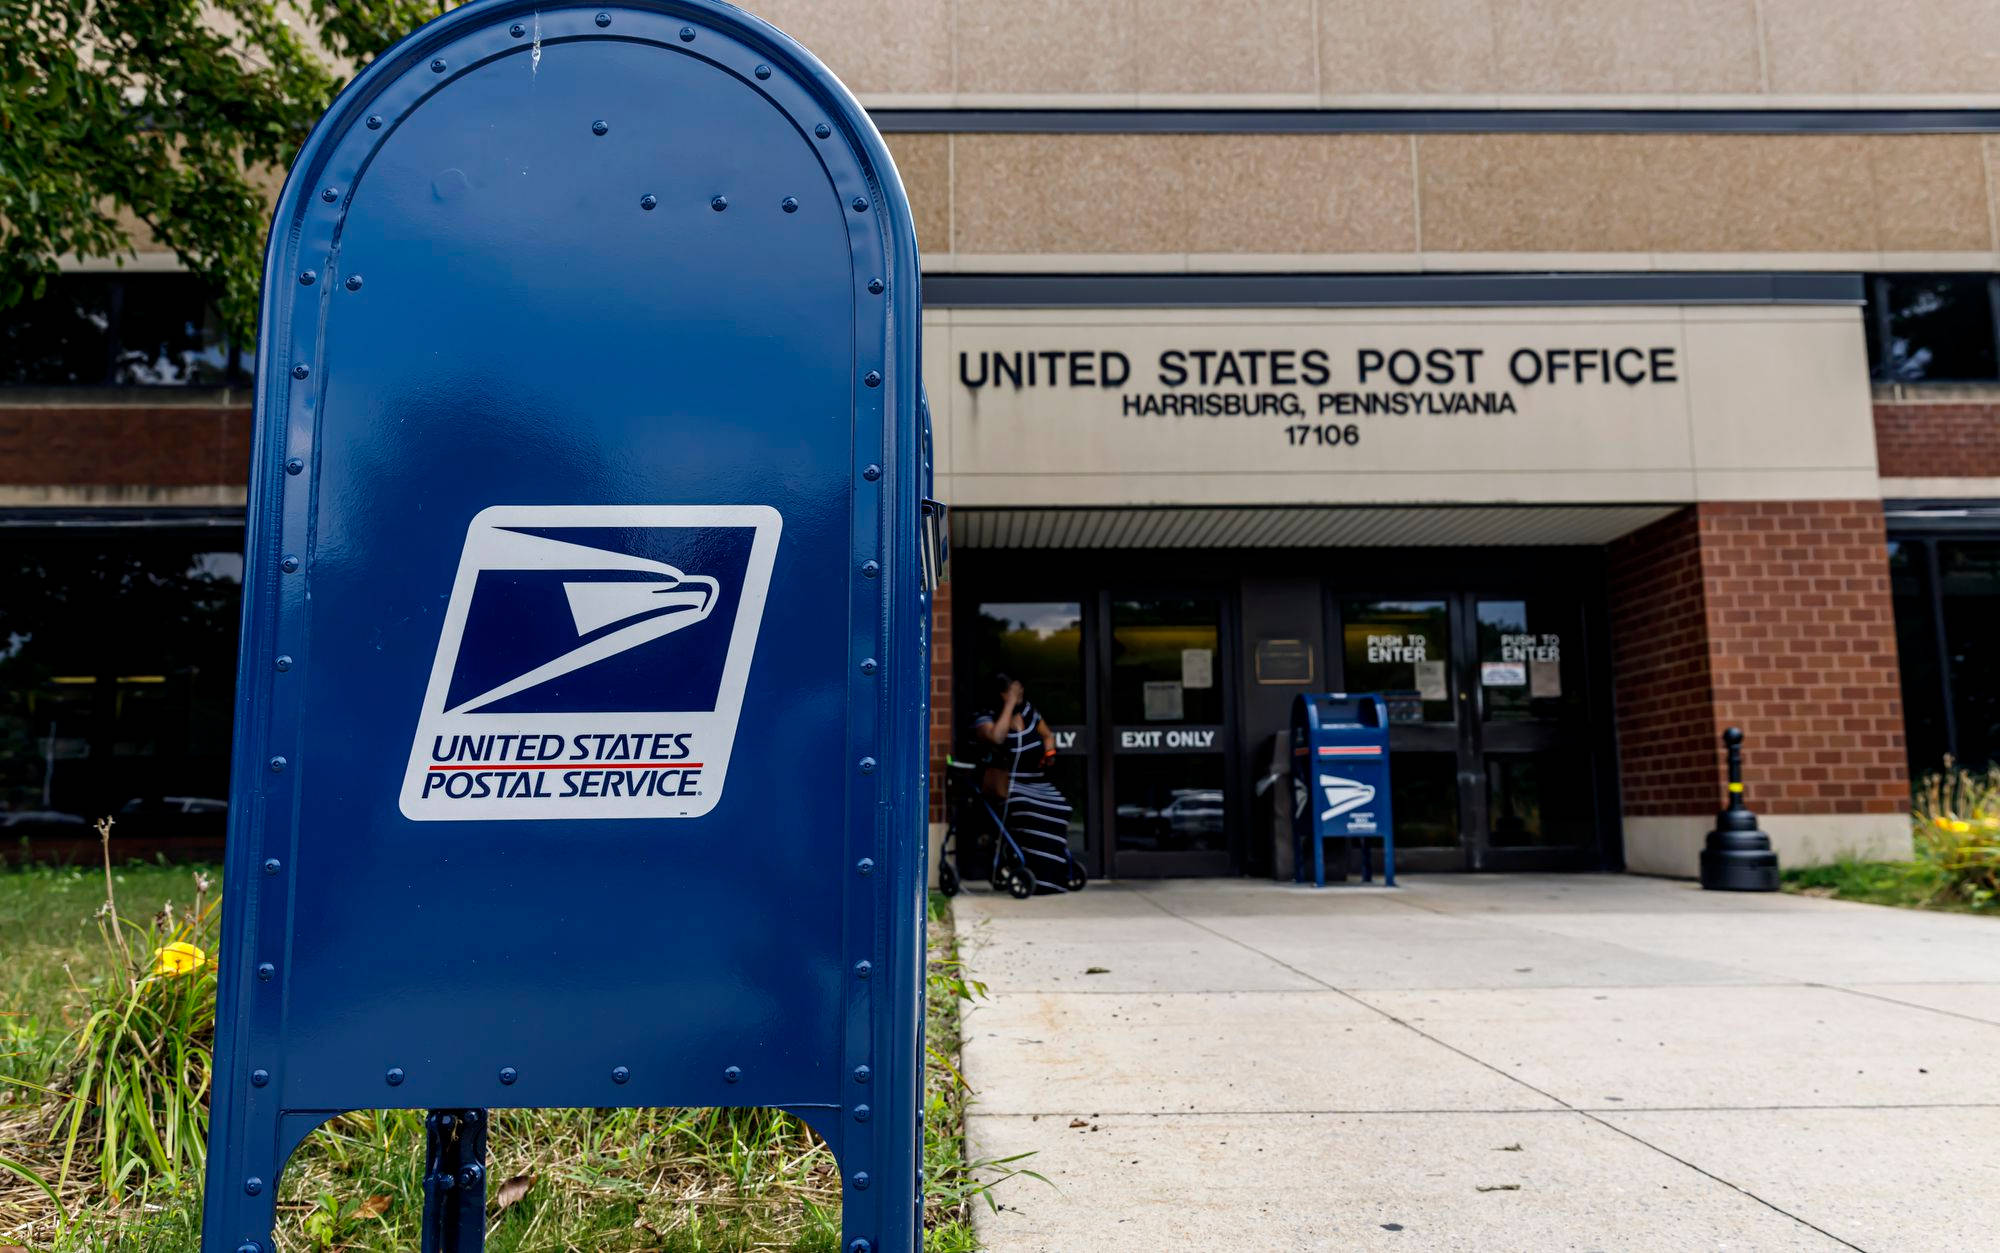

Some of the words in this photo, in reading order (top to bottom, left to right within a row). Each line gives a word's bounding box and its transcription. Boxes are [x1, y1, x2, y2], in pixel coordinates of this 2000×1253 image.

[959, 351, 1131, 388] UNITED
[1158, 350, 1331, 386] STATES
[1357, 349, 1484, 385] POST
[1509, 347, 1678, 384] OFFICE
[1122, 393, 1306, 419] HARRISBURG,
[1318, 391, 1517, 416] PENNSYLVANIA
[1285, 424, 1360, 447] 17106
[1367, 634, 1403, 647] PUSH
[1407, 634, 1426, 647] TO
[1542, 634, 1560, 647] TO
[1368, 646, 1426, 663] ENTER
[1501, 646, 1560, 662] ENTER
[431, 734, 565, 762] UNITED
[569, 733, 693, 761] STATES
[1121, 731, 1163, 748] EXIT
[1166, 731, 1215, 748] ONLY
[421, 771, 552, 800] POSTAL
